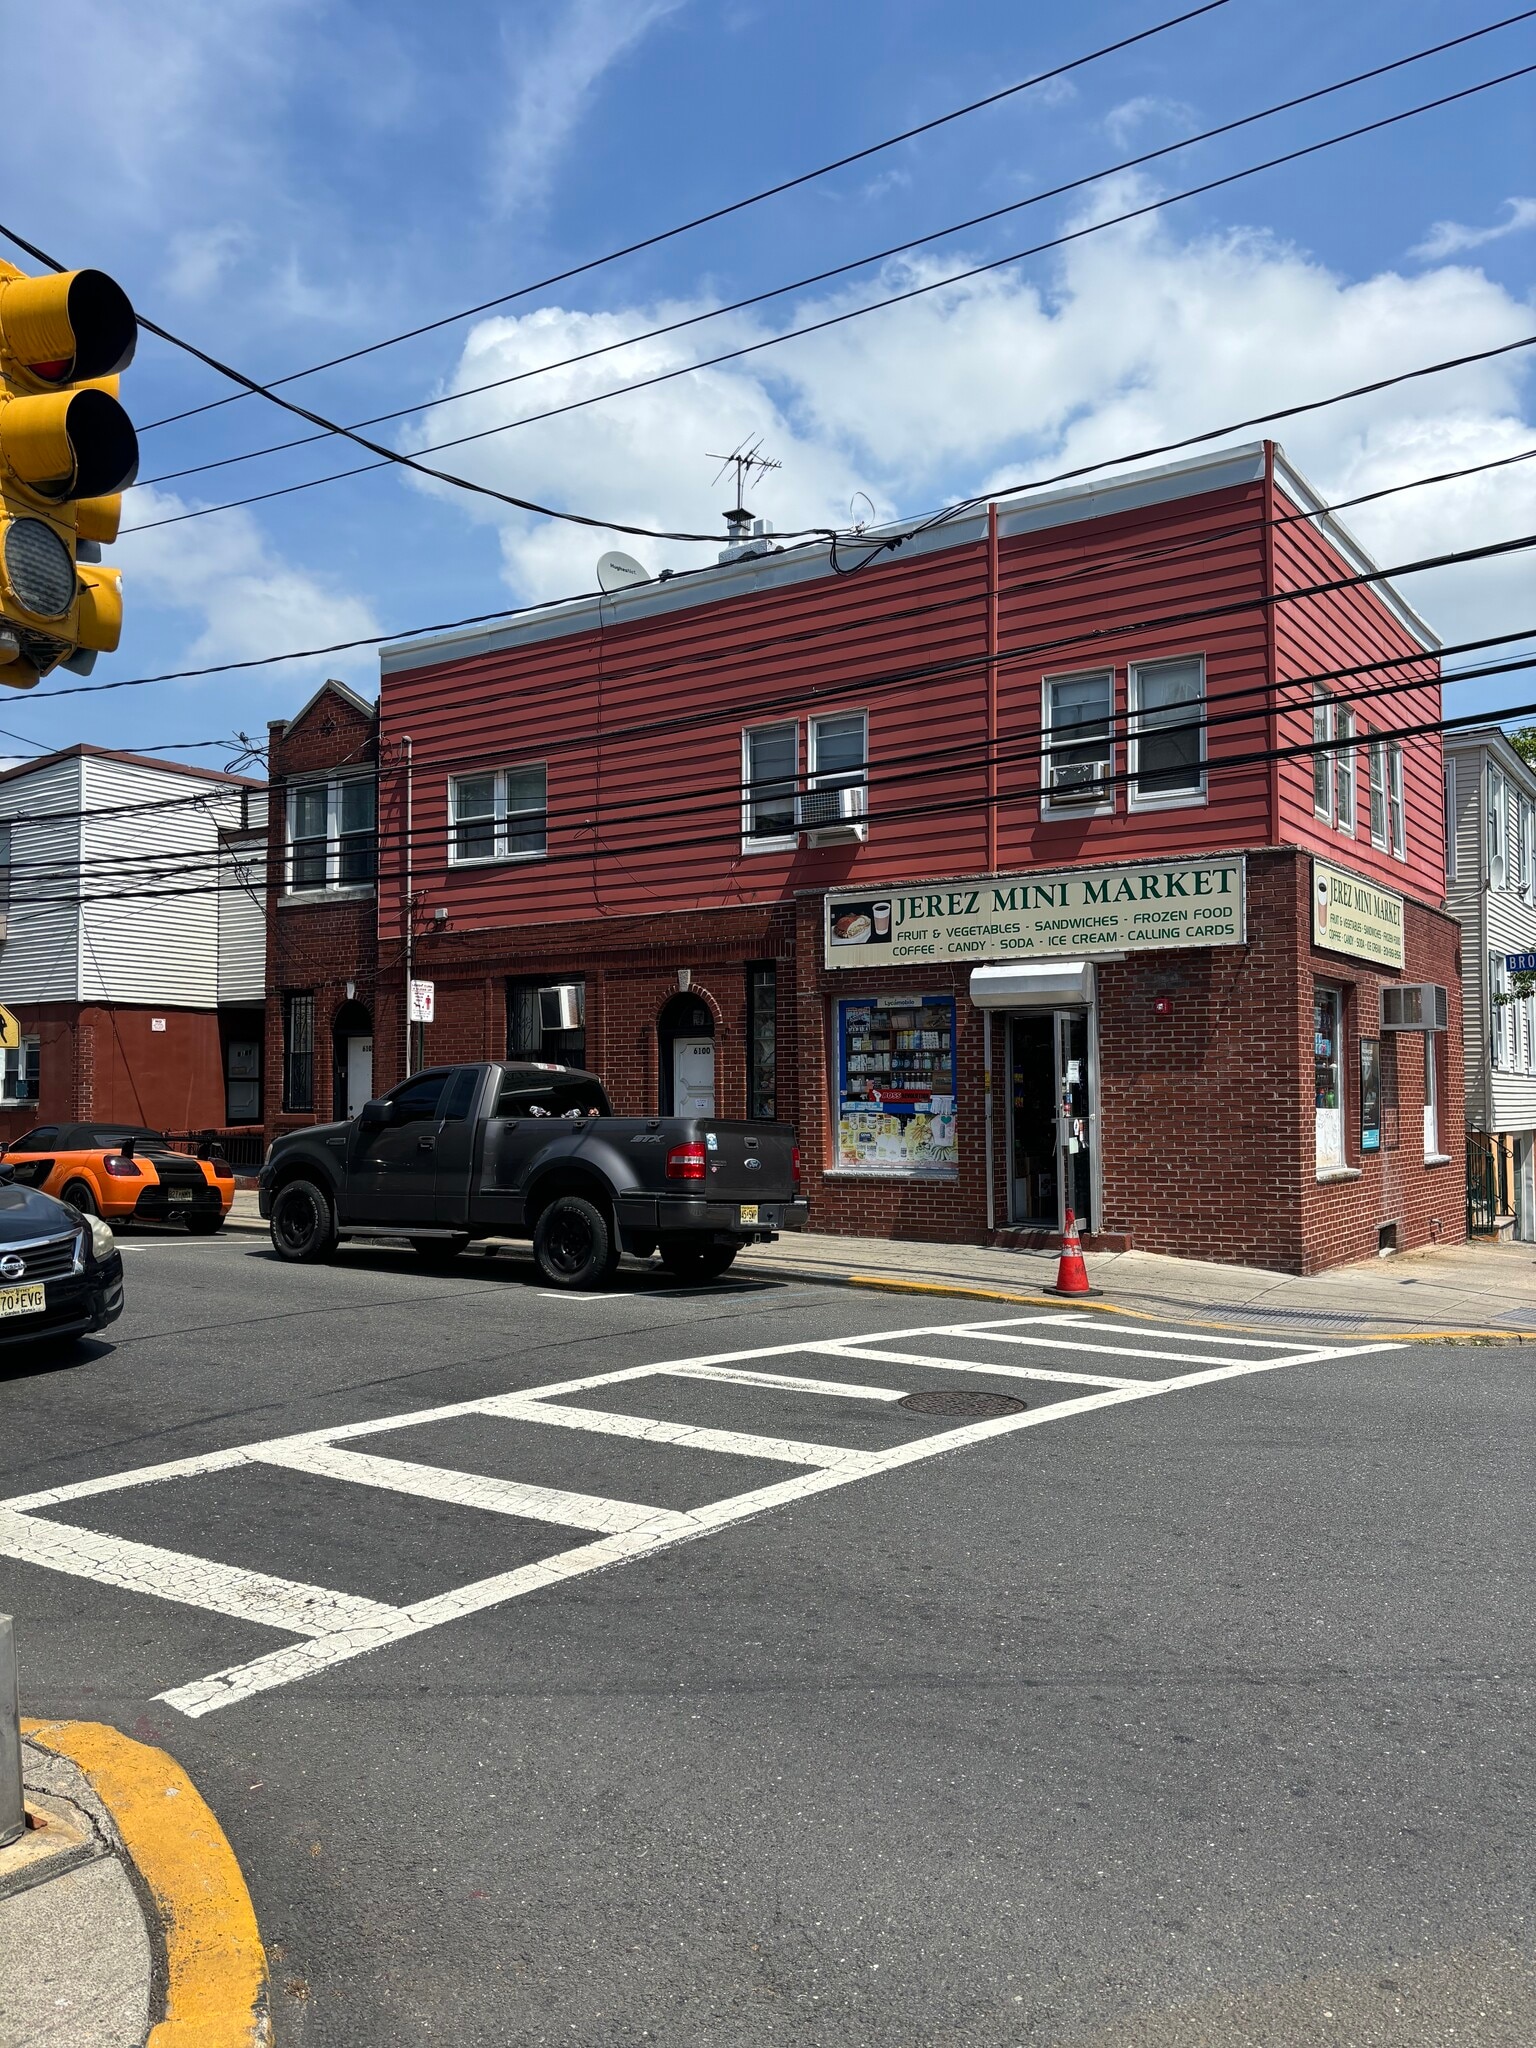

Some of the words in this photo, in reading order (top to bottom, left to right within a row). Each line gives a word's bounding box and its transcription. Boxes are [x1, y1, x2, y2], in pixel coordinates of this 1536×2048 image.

[895, 891, 980, 926] JEREZ
[992, 882, 1070, 912] MINI
[1082, 867, 1237, 905] MARKET
[1329, 877, 1352, 907] JEREZ
[1354, 886, 1372, 915] MINI
[1373, 894, 1401, 926] MARKET
[897, 929, 928, 941] FRUIT
[932, 929, 941, 939] &
[946, 922, 1020, 938] VEGETABLES
[1035, 915, 1119, 932] SANDWICHES
[1133, 910, 1188, 924] FROZEN
[1193, 906, 1233, 919] FOOD
[1329, 912, 1340, 925] FRUIT
[892, 944, 935, 957] COFFEE
[947, 940, 987, 953] CANDY
[1000, 938, 1034, 950] SODA
[1048, 935, 1067, 946] ICE
[1072, 931, 1118, 945] CREAM
[1127, 928, 1180, 941] CALLING
[1186, 923, 1235, 937] CARDS
[1328, 928, 1342, 942] COFFEE
[693, 1047, 711, 1055] 6100
[881, 1091, 902, 1099] BOSS
[630, 1134, 665, 1143] STX
